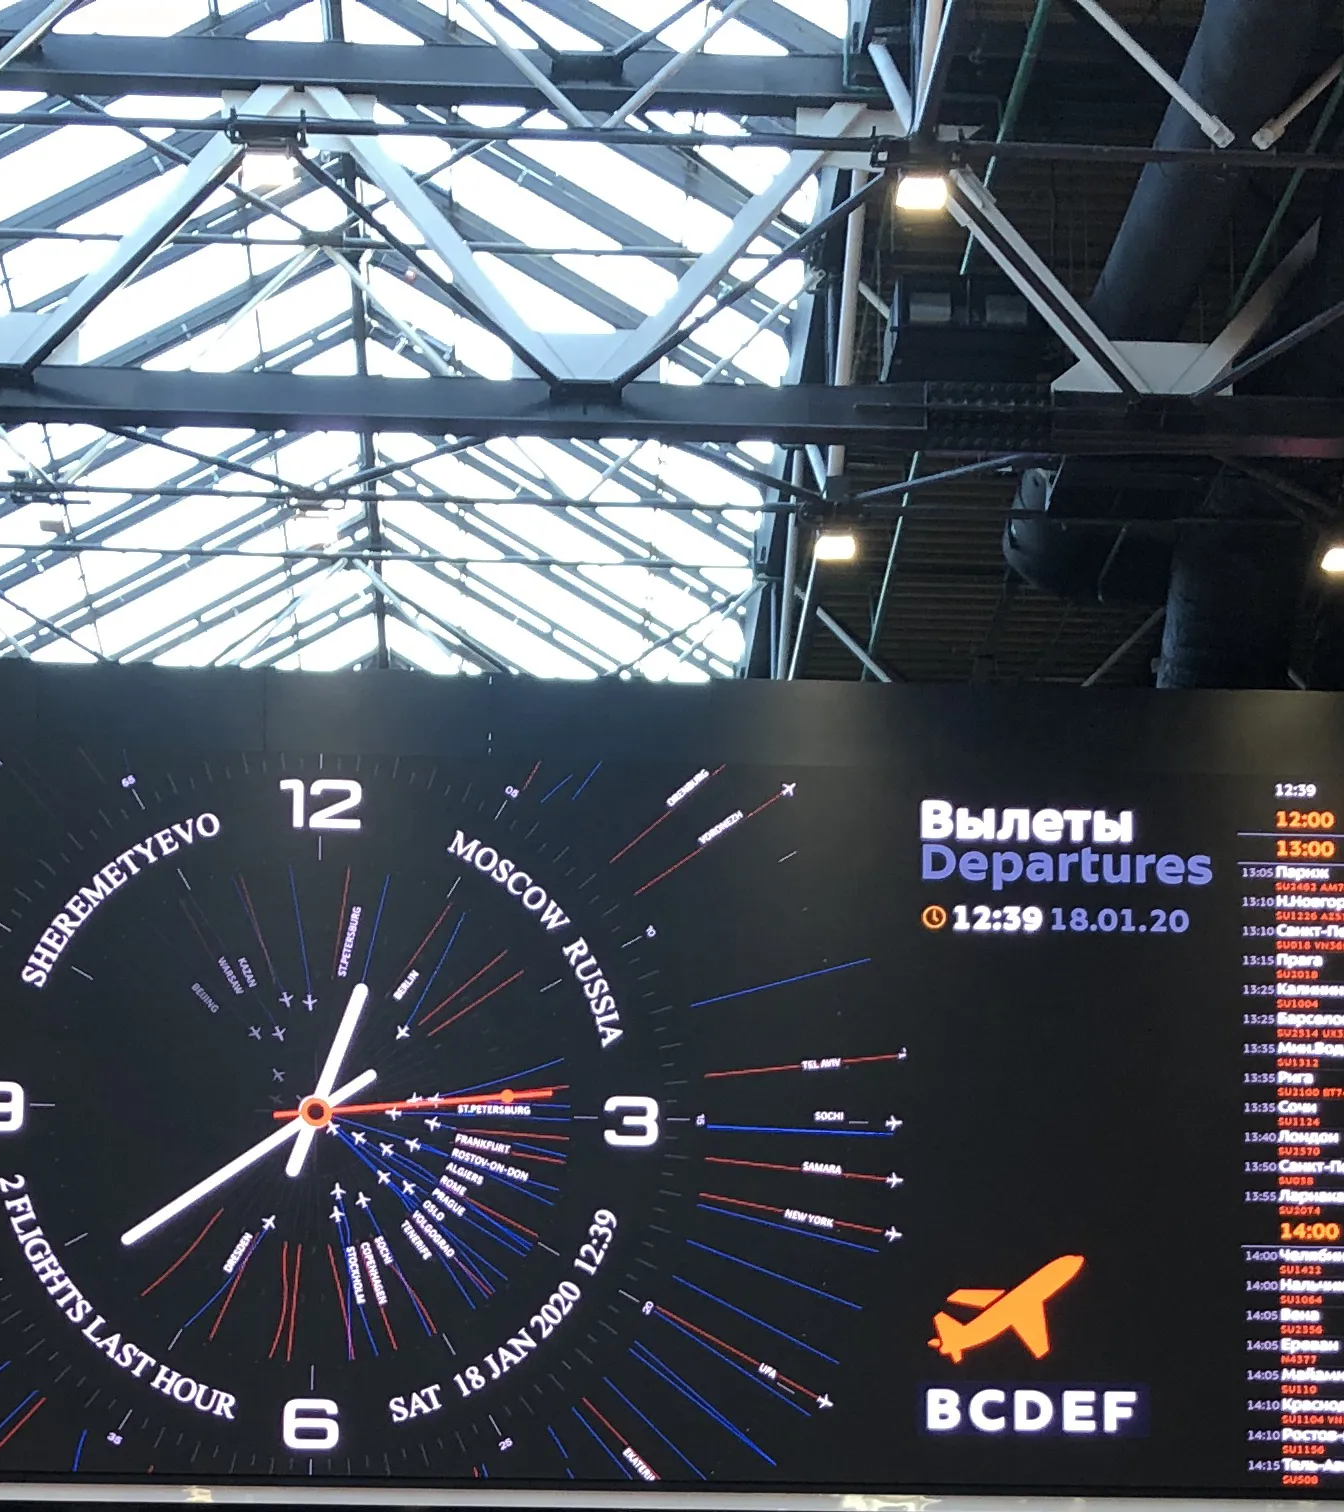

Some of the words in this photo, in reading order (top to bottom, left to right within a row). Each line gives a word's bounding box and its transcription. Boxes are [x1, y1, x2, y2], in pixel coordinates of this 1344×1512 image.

[280, 779, 361, 828] 12
[1275, 784, 1316, 797] 12:39
[920, 800, 1133, 842] Вылеты
[1276, 811, 1334, 828] 12:00
[1276, 841, 1334, 857] 13:00
[922, 844, 1213, 890] Departures
[1276, 866, 1329, 881] Париж
[21, 813, 220, 988] SHEREMETYEVO
[953, 905, 1043, 930] 12:39
[1051, 908, 1189, 932] 18.01.20
[447, 830, 571, 931] MOSCOW
[562, 937, 623, 1048] RUSSIA
[218, 956, 245, 995] WARSAW
[238, 957, 258, 988] KAZAN
[393, 969, 419, 1001] BERLIN
[191, 982, 219, 1014] BEIJING
[801, 1060, 819, 1070] TEL
[821, 1058, 841, 1069] AVIV
[604, 1096, 658, 1146] 3
[814, 1111, 844, 1121] SOCHI
[455, 1133, 511, 1154] FRANKFURT
[445, 1162, 484, 1186] ALGIERS
[451, 1148, 529, 1182] ROSTOV-ON-DON
[802, 1161, 842, 1175] SAMARA
[440, 1175, 468, 1196] ROME
[422, 1200, 445, 1221] OSLO
[432, 1188, 467, 1217] PRAGUE
[784, 1209, 807, 1222] NEW
[808, 1214, 834, 1227] YORK
[401, 1219, 432, 1260] TENERIFE
[412, 1210, 455, 1258] VOLGOGRAD
[1281, 1223, 1339, 1240] 14:00
[223, 1232, 253, 1274] DRESDEN
[374, 1236, 393, 1265] SOCHI
[346, 1246, 366, 1304] STOCKHOLM
[360, 1242, 388, 1305] COPENHAGEN
[4, 1194, 93, 1323] FLIGHTS
[82, 1315, 156, 1377] LAST
[151, 1365, 236, 1419] HOUR
[389, 1385, 442, 1422] SAT
[454, 1366, 486, 1397] 18
[484, 1328, 536, 1379] JAN
[530, 1281, 581, 1338] 2020
[574, 1209, 618, 1276] 12:39
[642, 1300, 654, 1315] 20
[282, 1399, 339, 1449] 6
[927, 1390, 1138, 1431] BCDEF
[498, 1438, 514, 1451] 25
